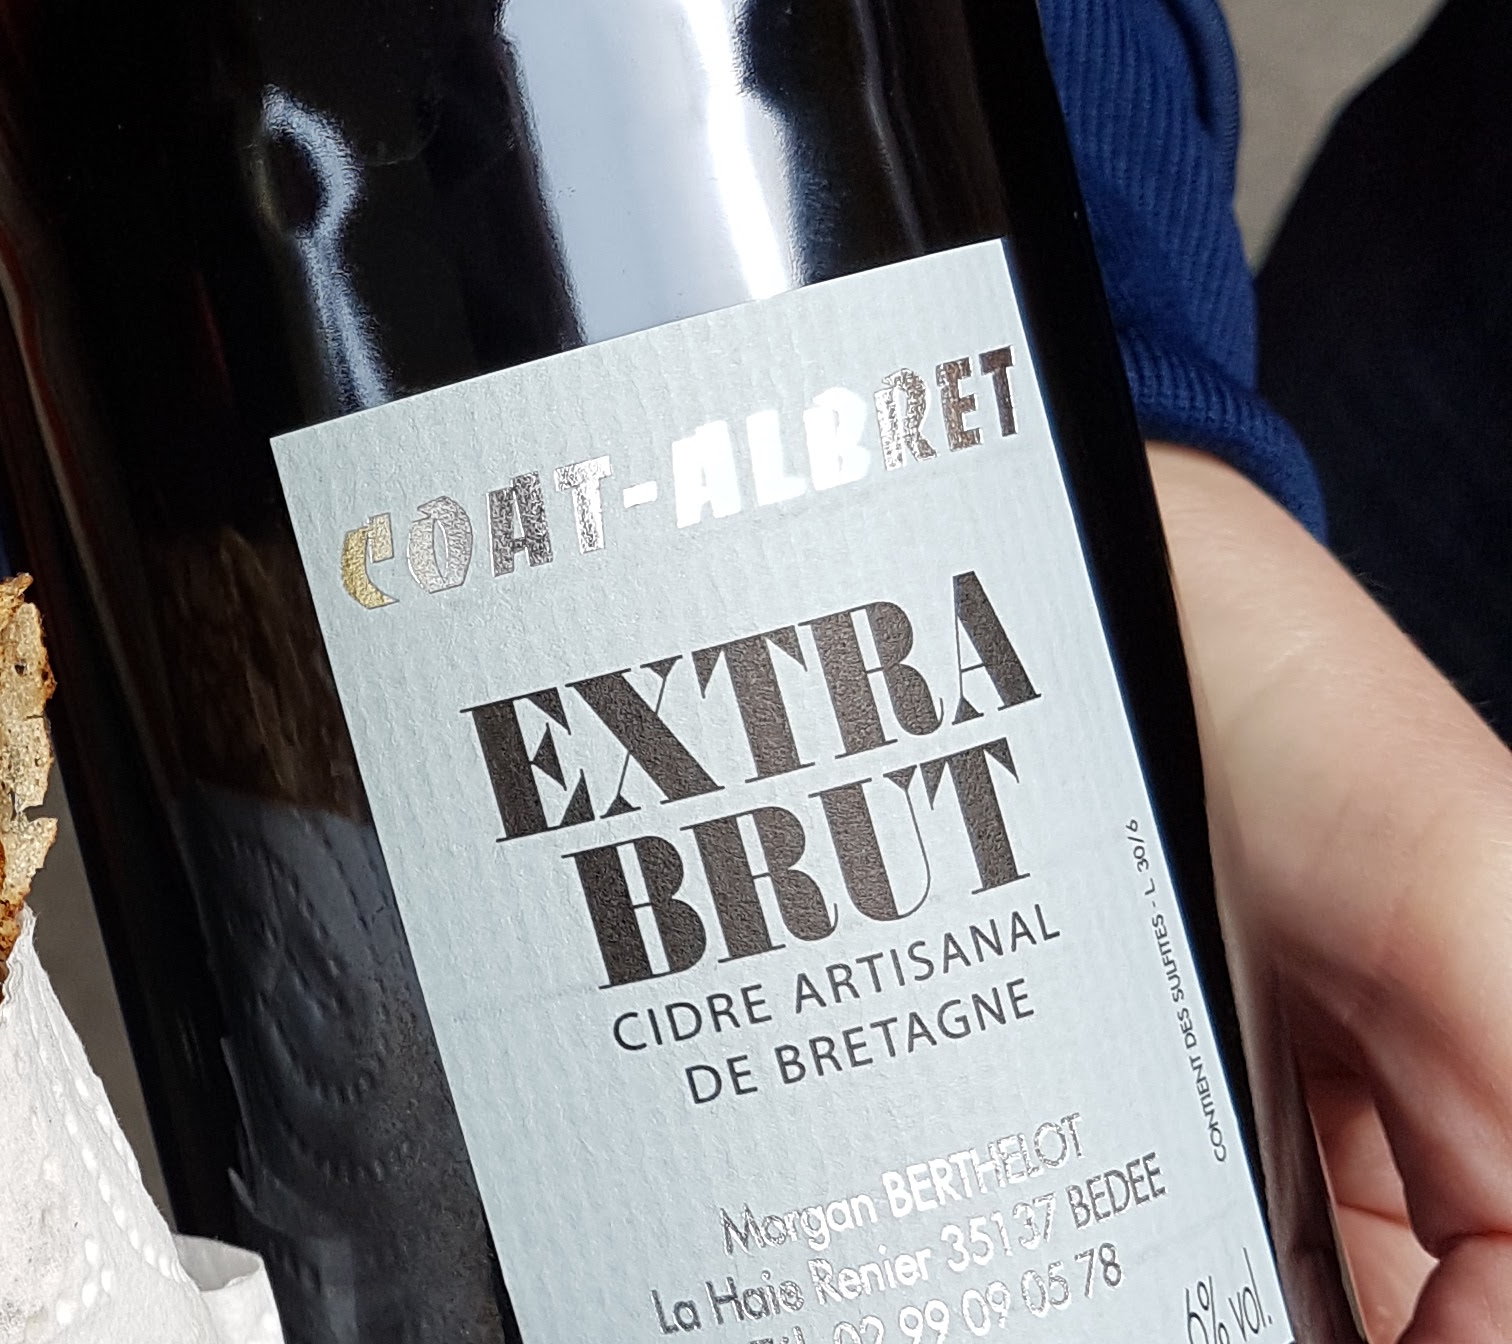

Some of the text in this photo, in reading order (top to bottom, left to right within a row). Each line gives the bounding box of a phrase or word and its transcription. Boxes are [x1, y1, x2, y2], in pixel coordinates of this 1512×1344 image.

[340, 344, 1019, 610] COAT-ALBRET
[459, 570, 1042, 843] EXTRA
[561, 736, 1031, 990] BRUT
[1125, 818, 1150, 873] 30/6
[1144, 877, 1157, 896] L
[612, 902, 1062, 1052] CIDRE ARTISANAL
[1151, 913, 1185, 1003] SULFITES
[684, 977, 1035, 1105] DE BRETAGNE
[1177, 1007, 1198, 1050] DES
[1189, 1055, 1227, 1163] CONTIENT
[650, 1151, 1167, 1335] La Haie Renier 35137 BEDEE
[719, 1111, 1087, 1258] Morgan BERTHELOT
[961, 1282, 1012, 1338] 09
[1021, 1260, 1071, 1319] 05
[1074, 1241, 1125, 1300] 78
[1227, 1247, 1274, 1338] vol.
